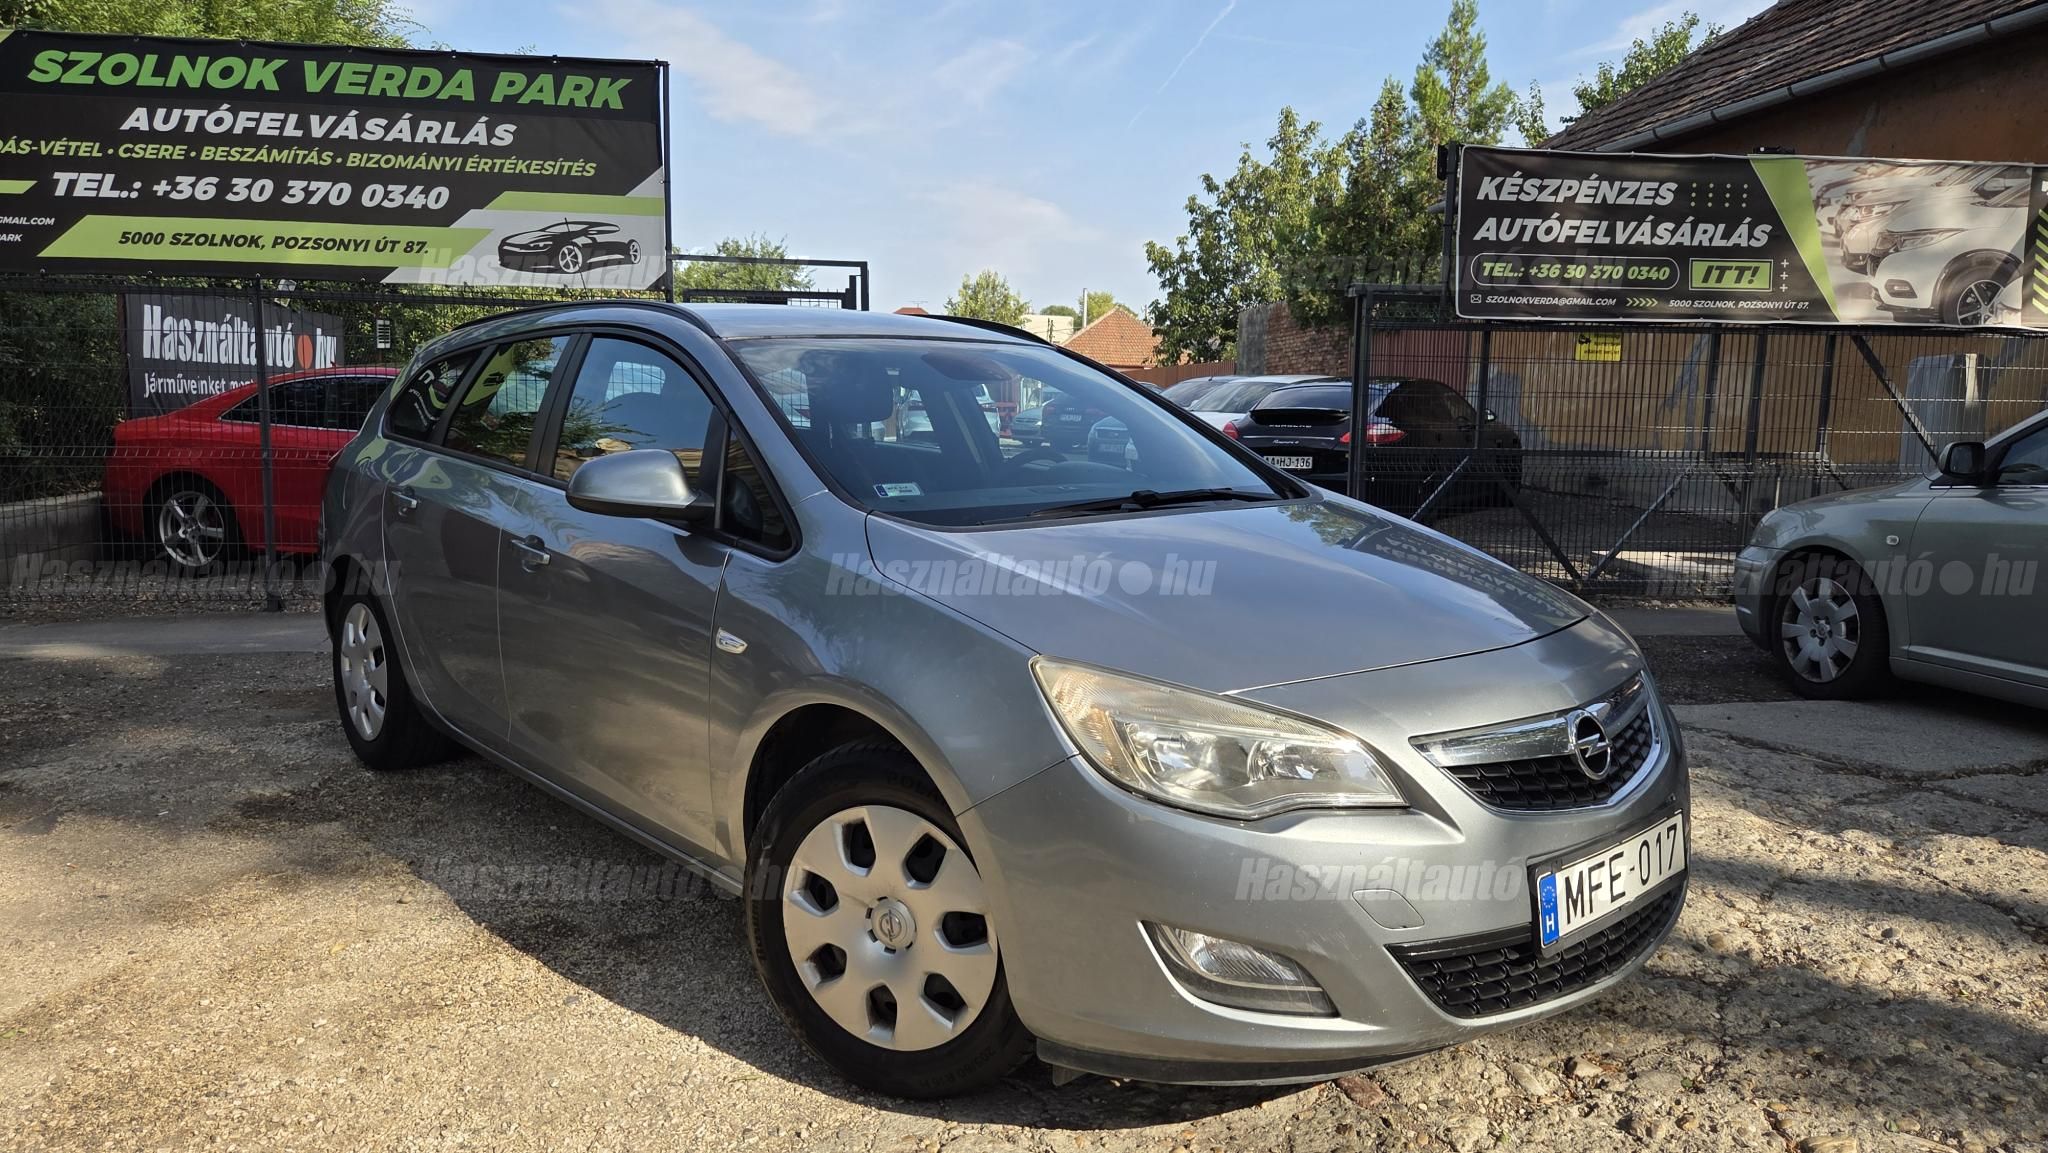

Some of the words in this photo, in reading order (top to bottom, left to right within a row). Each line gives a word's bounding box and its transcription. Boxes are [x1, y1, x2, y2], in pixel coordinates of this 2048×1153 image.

[28, 50, 288, 91] SZOLNOK
[304, 60, 475, 101] VERDA
[490, 71, 632, 109] PARK
[120, 103, 518, 146] AUTÓFELVÁSÁRLÁS
[118, 143, 188, 160] CSERE
[200, 145, 334, 166] BESZÁMÍTÁS
[346, 152, 461, 172] BIZOMÁNYI
[465, 156, 596, 177] ÉRTÉKESÍTÉS
[53, 171, 143, 199] TEL.:
[152, 175, 220, 201] +36
[225, 177, 274, 203] 30
[281, 180, 352, 206] 370
[361, 183, 450, 210] 0340
[1476, 170, 1678, 205] KÉSZPÉNZES
[119, 231, 165, 246] 5000
[169, 232, 265, 250] SZOLNOK,
[271, 235, 372, 252] POZSONYI
[374, 235, 400, 253] ÚT
[404, 241, 429, 254] 87.
[1473, 213, 1772, 247] AUTÓFELVÁSÁRLÁS
[1482, 262, 1524, 277] TEL.:
[1529, 262, 1561, 278] +36
[1564, 264, 1586, 279] 30
[1590, 265, 1623, 279] 370
[1628, 266, 1670, 281] 0340
[1701, 265, 1760, 284] ITT!
[1485, 295, 1616, 306] SZOLNOKVERDA@GMAIL.COM
[1669, 300, 1692, 308] 5000
[1693, 300, 1735, 309] SZOLNOK,
[1738, 300, 1783, 309] POZSONYI
[1784, 300, 1797, 309] ÚT
[1565, 823, 1677, 925] MFE-017
[1545, 913, 1555, 934] H
